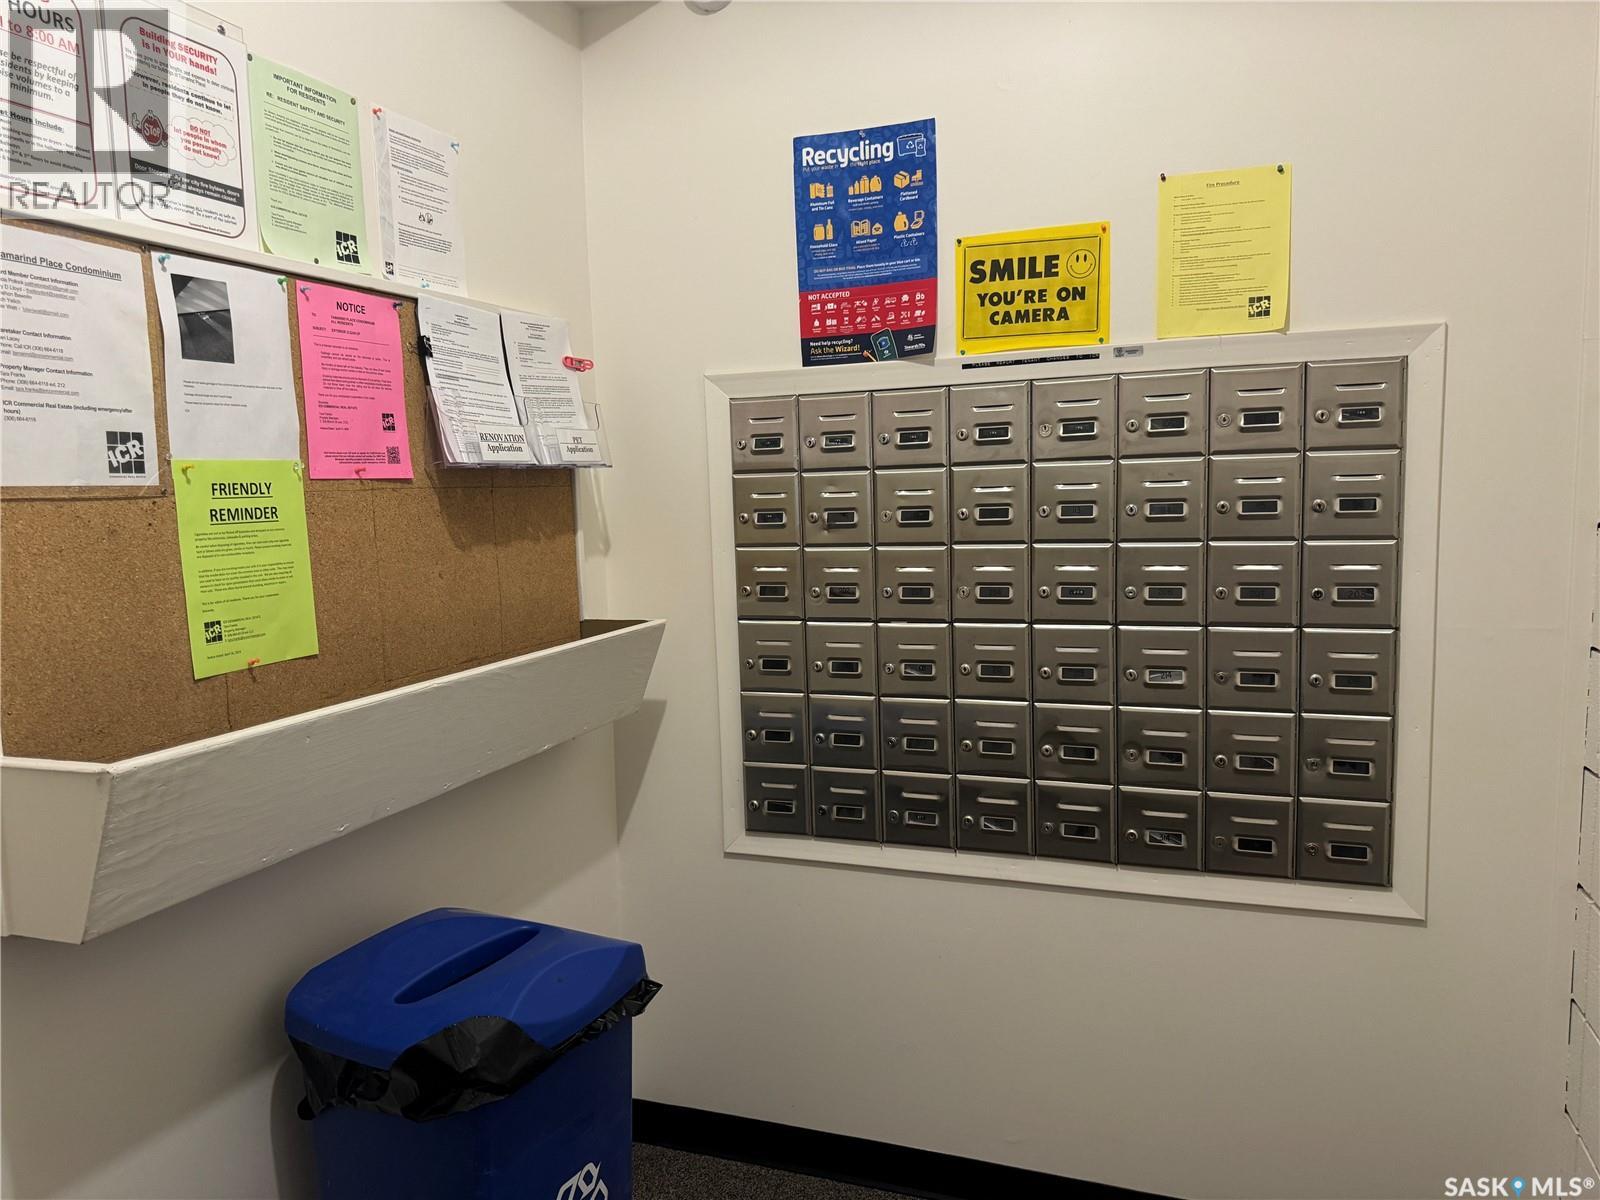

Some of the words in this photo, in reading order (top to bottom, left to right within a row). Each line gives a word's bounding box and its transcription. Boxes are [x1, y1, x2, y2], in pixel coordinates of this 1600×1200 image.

[9, 0, 76, 33] HOURS
[9, 19, 22, 34] to
[26, 25, 55, 45] 8:00
[59, 37, 80, 55] AM
[139, 26, 176, 50] Building
[178, 43, 218, 64] SECURITY
[11, 52, 22, 63] be
[24, 57, 66, 77] respectful
[68, 72, 78, 82] of
[164, 47, 187, 64] YOUR
[189, 58, 217, 76] hands!
[11, 81, 54, 102] minimum.
[16, 74, 52, 92] volumes
[55, 86, 63, 95] to
[35, 70, 45, 80] by
[47, 74, 80, 92] keeping
[273, 73, 303, 90] IMPORTANT
[304, 86, 337, 104] INFORMATION
[287, 86, 298, 95] FOR
[298, 91, 326, 106] RESIDENTS
[801, 140, 894, 168] Recycling
[0, 251, 37, 264] amarind
[40, 257, 63, 269] Place
[66, 262, 121, 279] Condominium
[969, 254, 1060, 284] SMILE
[821, 291, 850, 299] ACCEPTED
[977, 289, 1047, 307] YOU'RE
[1056, 286, 1086, 301] ON
[336, 301, 366, 314] NOTICE
[989, 307, 1069, 326] CAMERA
[810, 347, 822, 355] Ask
[823, 346, 834, 354] the
[835, 344, 860, 353] Wizard!
[479, 432, 525, 443] RENOVATION
[487, 443, 523, 453] Application
[572, 436, 583, 444] PET
[108, 440, 144, 467] ICR
[566, 445, 593, 454] Application
[211, 482, 272, 496] FRIENDLY
[210, 506, 279, 522] REMINDER
